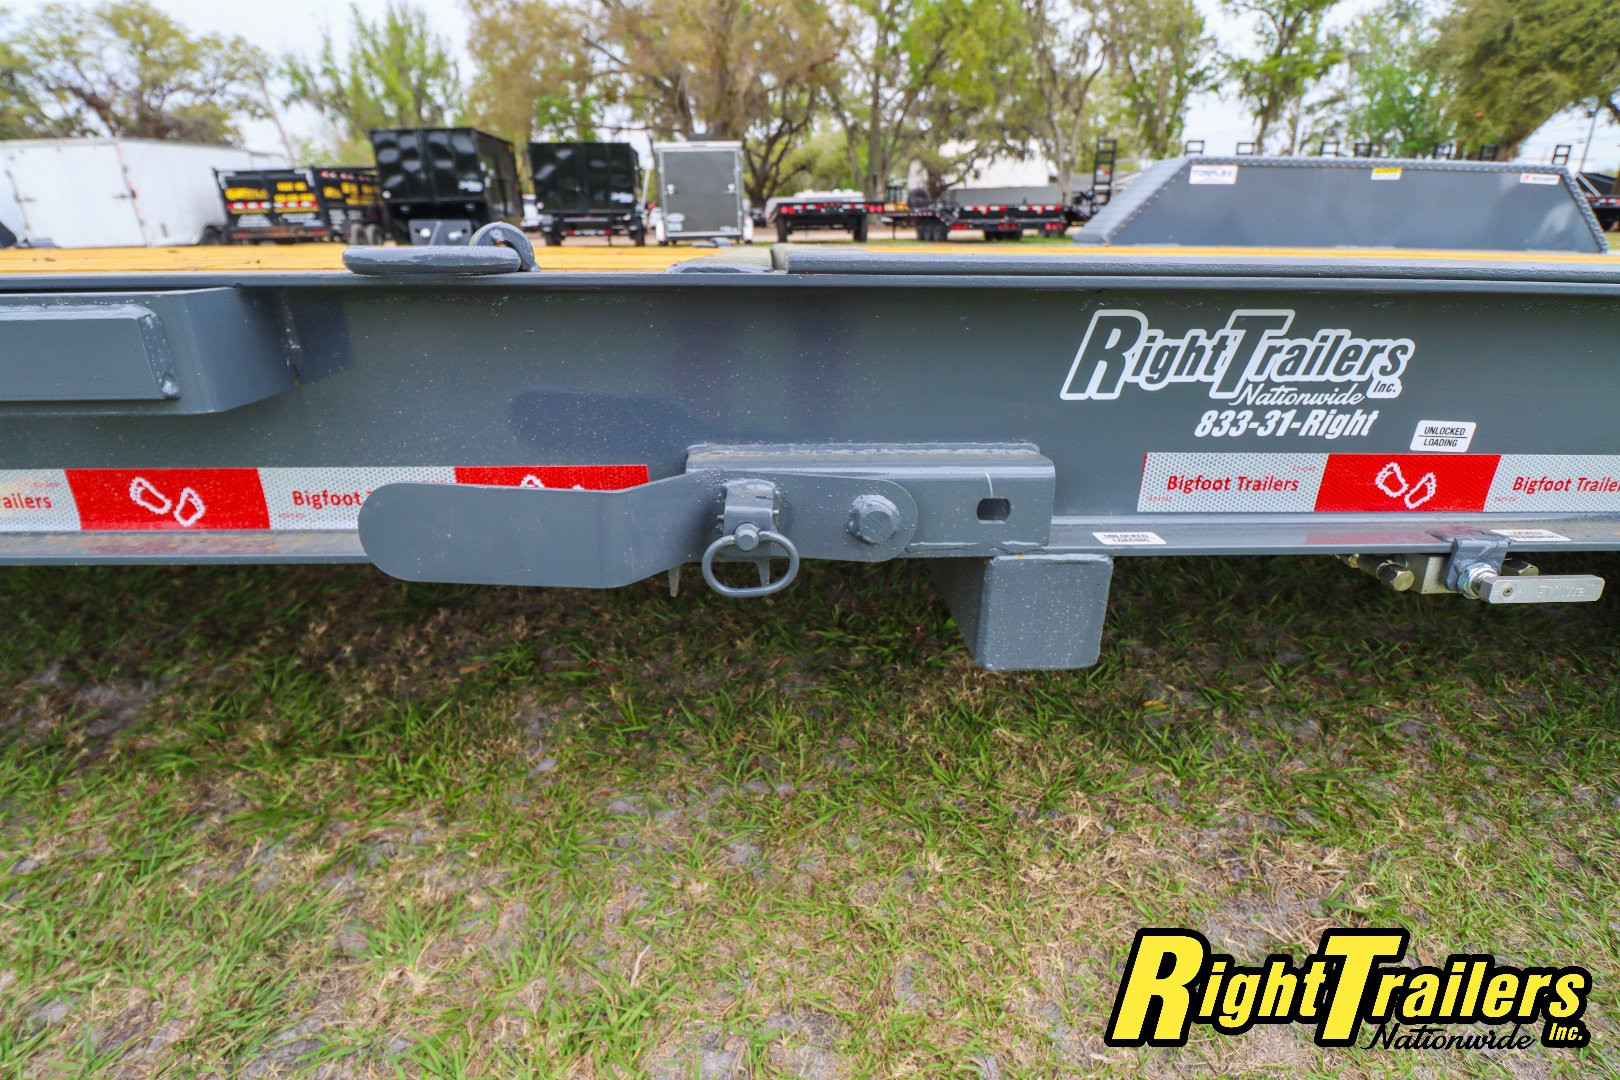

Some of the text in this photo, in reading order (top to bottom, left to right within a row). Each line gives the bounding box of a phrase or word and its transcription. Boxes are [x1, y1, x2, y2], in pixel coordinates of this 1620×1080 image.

[1228, 383, 1366, 406] Nationwide
[1372, 380, 1397, 393] Inc.
[1194, 408, 1380, 439] 833-31-Right
[1424, 426, 1466, 436] UNLOCKED
[1423, 438, 1458, 447] LOADING
[1167, 475, 1299, 494] Bigfoot Trailers
[1512, 476, 1571, 495] Bigfoot
[292, 489, 361, 510] Bigfoot
